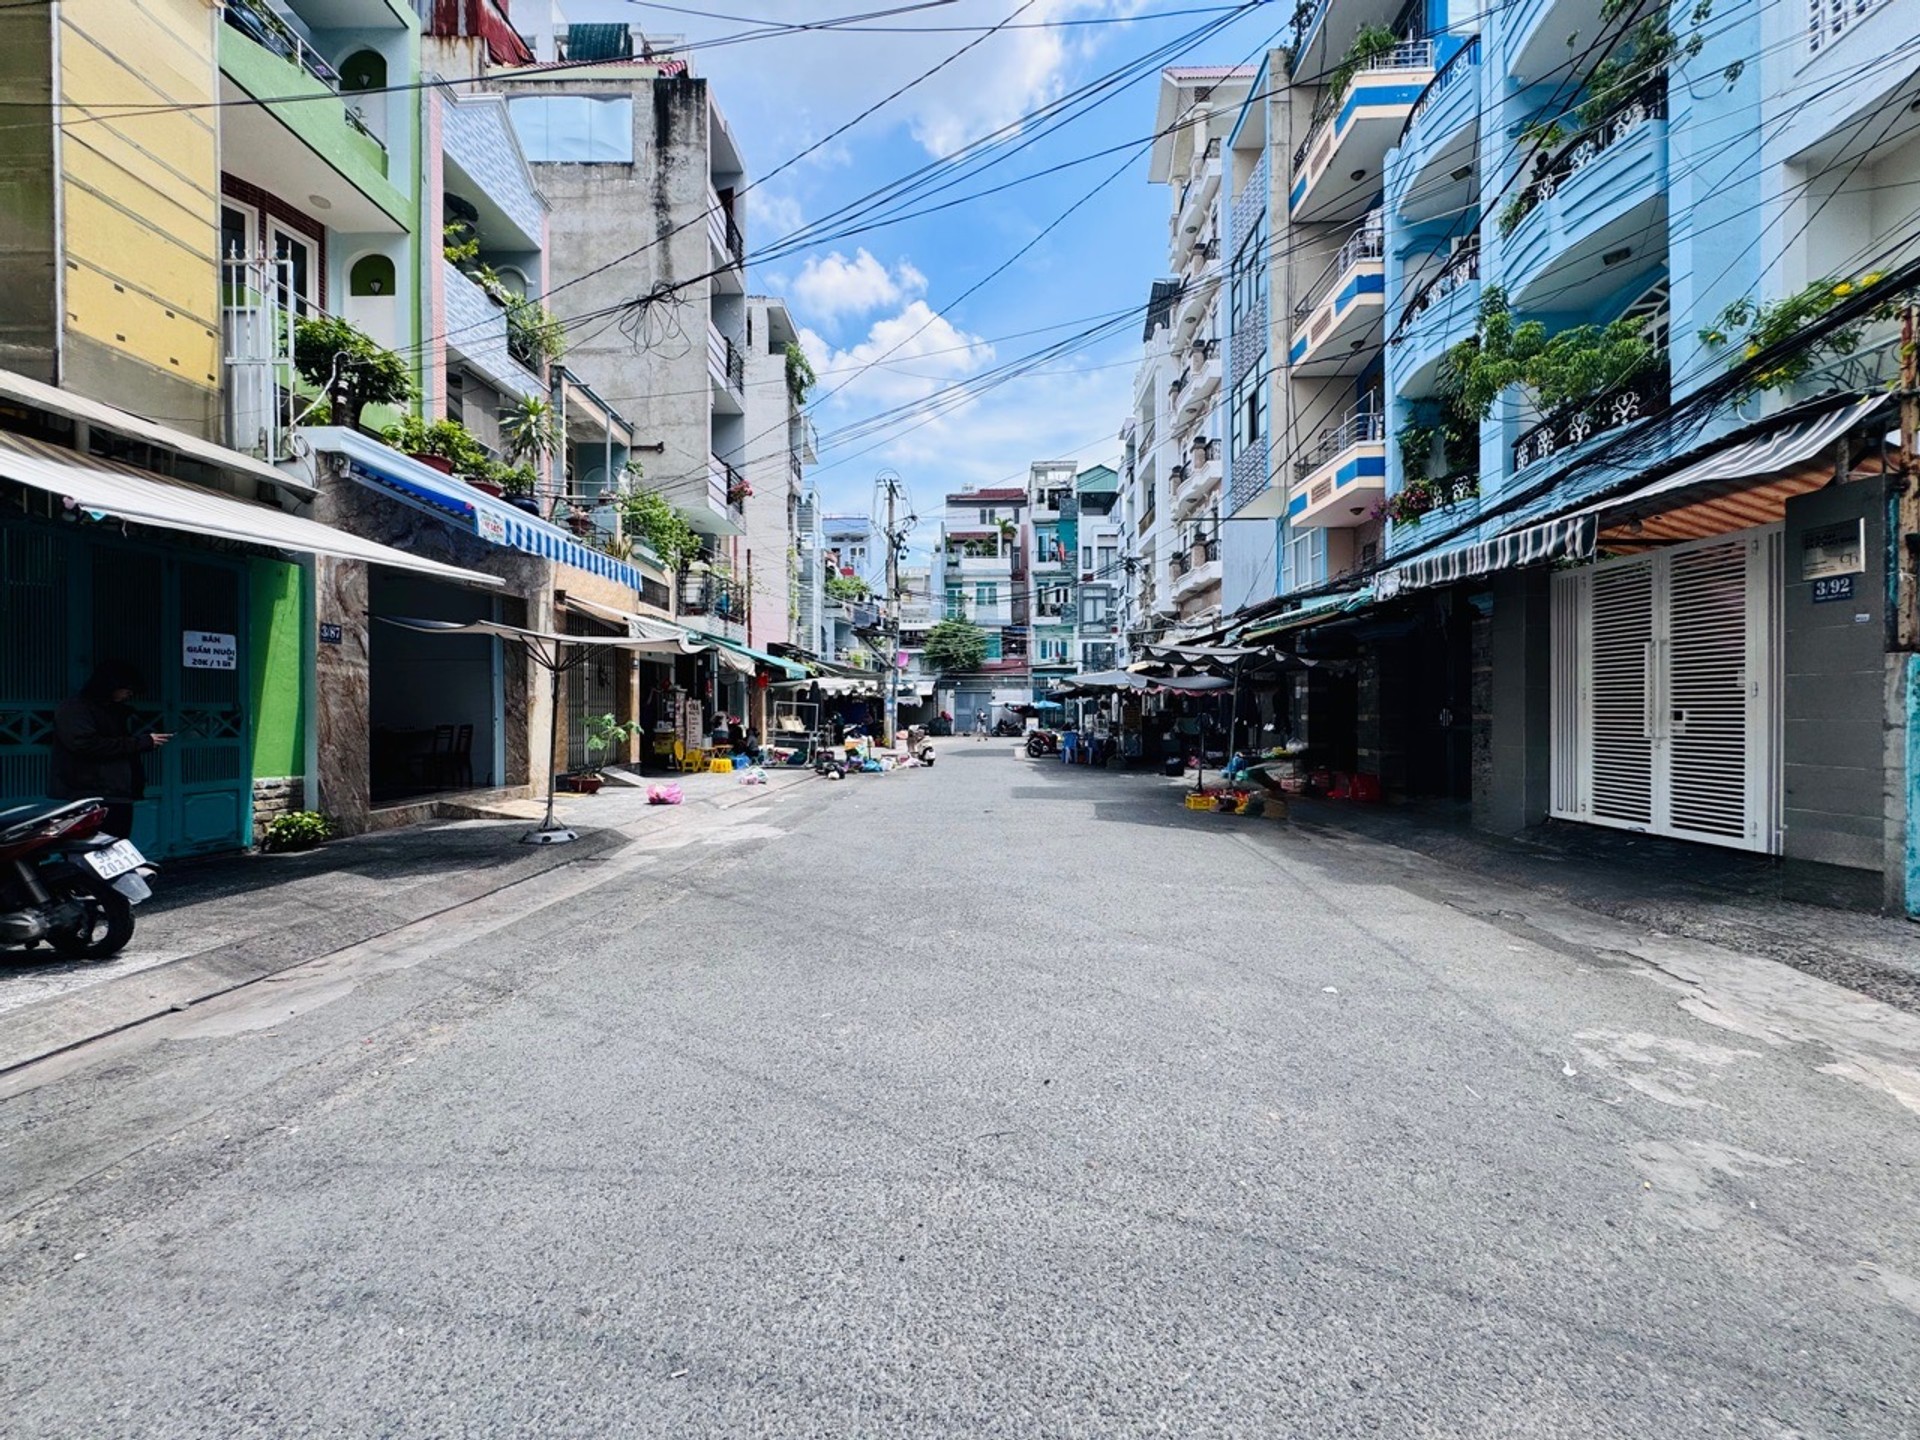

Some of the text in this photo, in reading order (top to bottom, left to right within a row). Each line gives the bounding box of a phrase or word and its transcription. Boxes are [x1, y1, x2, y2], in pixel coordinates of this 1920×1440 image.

[1816, 578, 1850, 595] 3/92
[321, 625, 340, 638] 3/87
[202, 635, 221, 643] BÁN
[187, 644, 235, 656] GIẤM NUÔI
